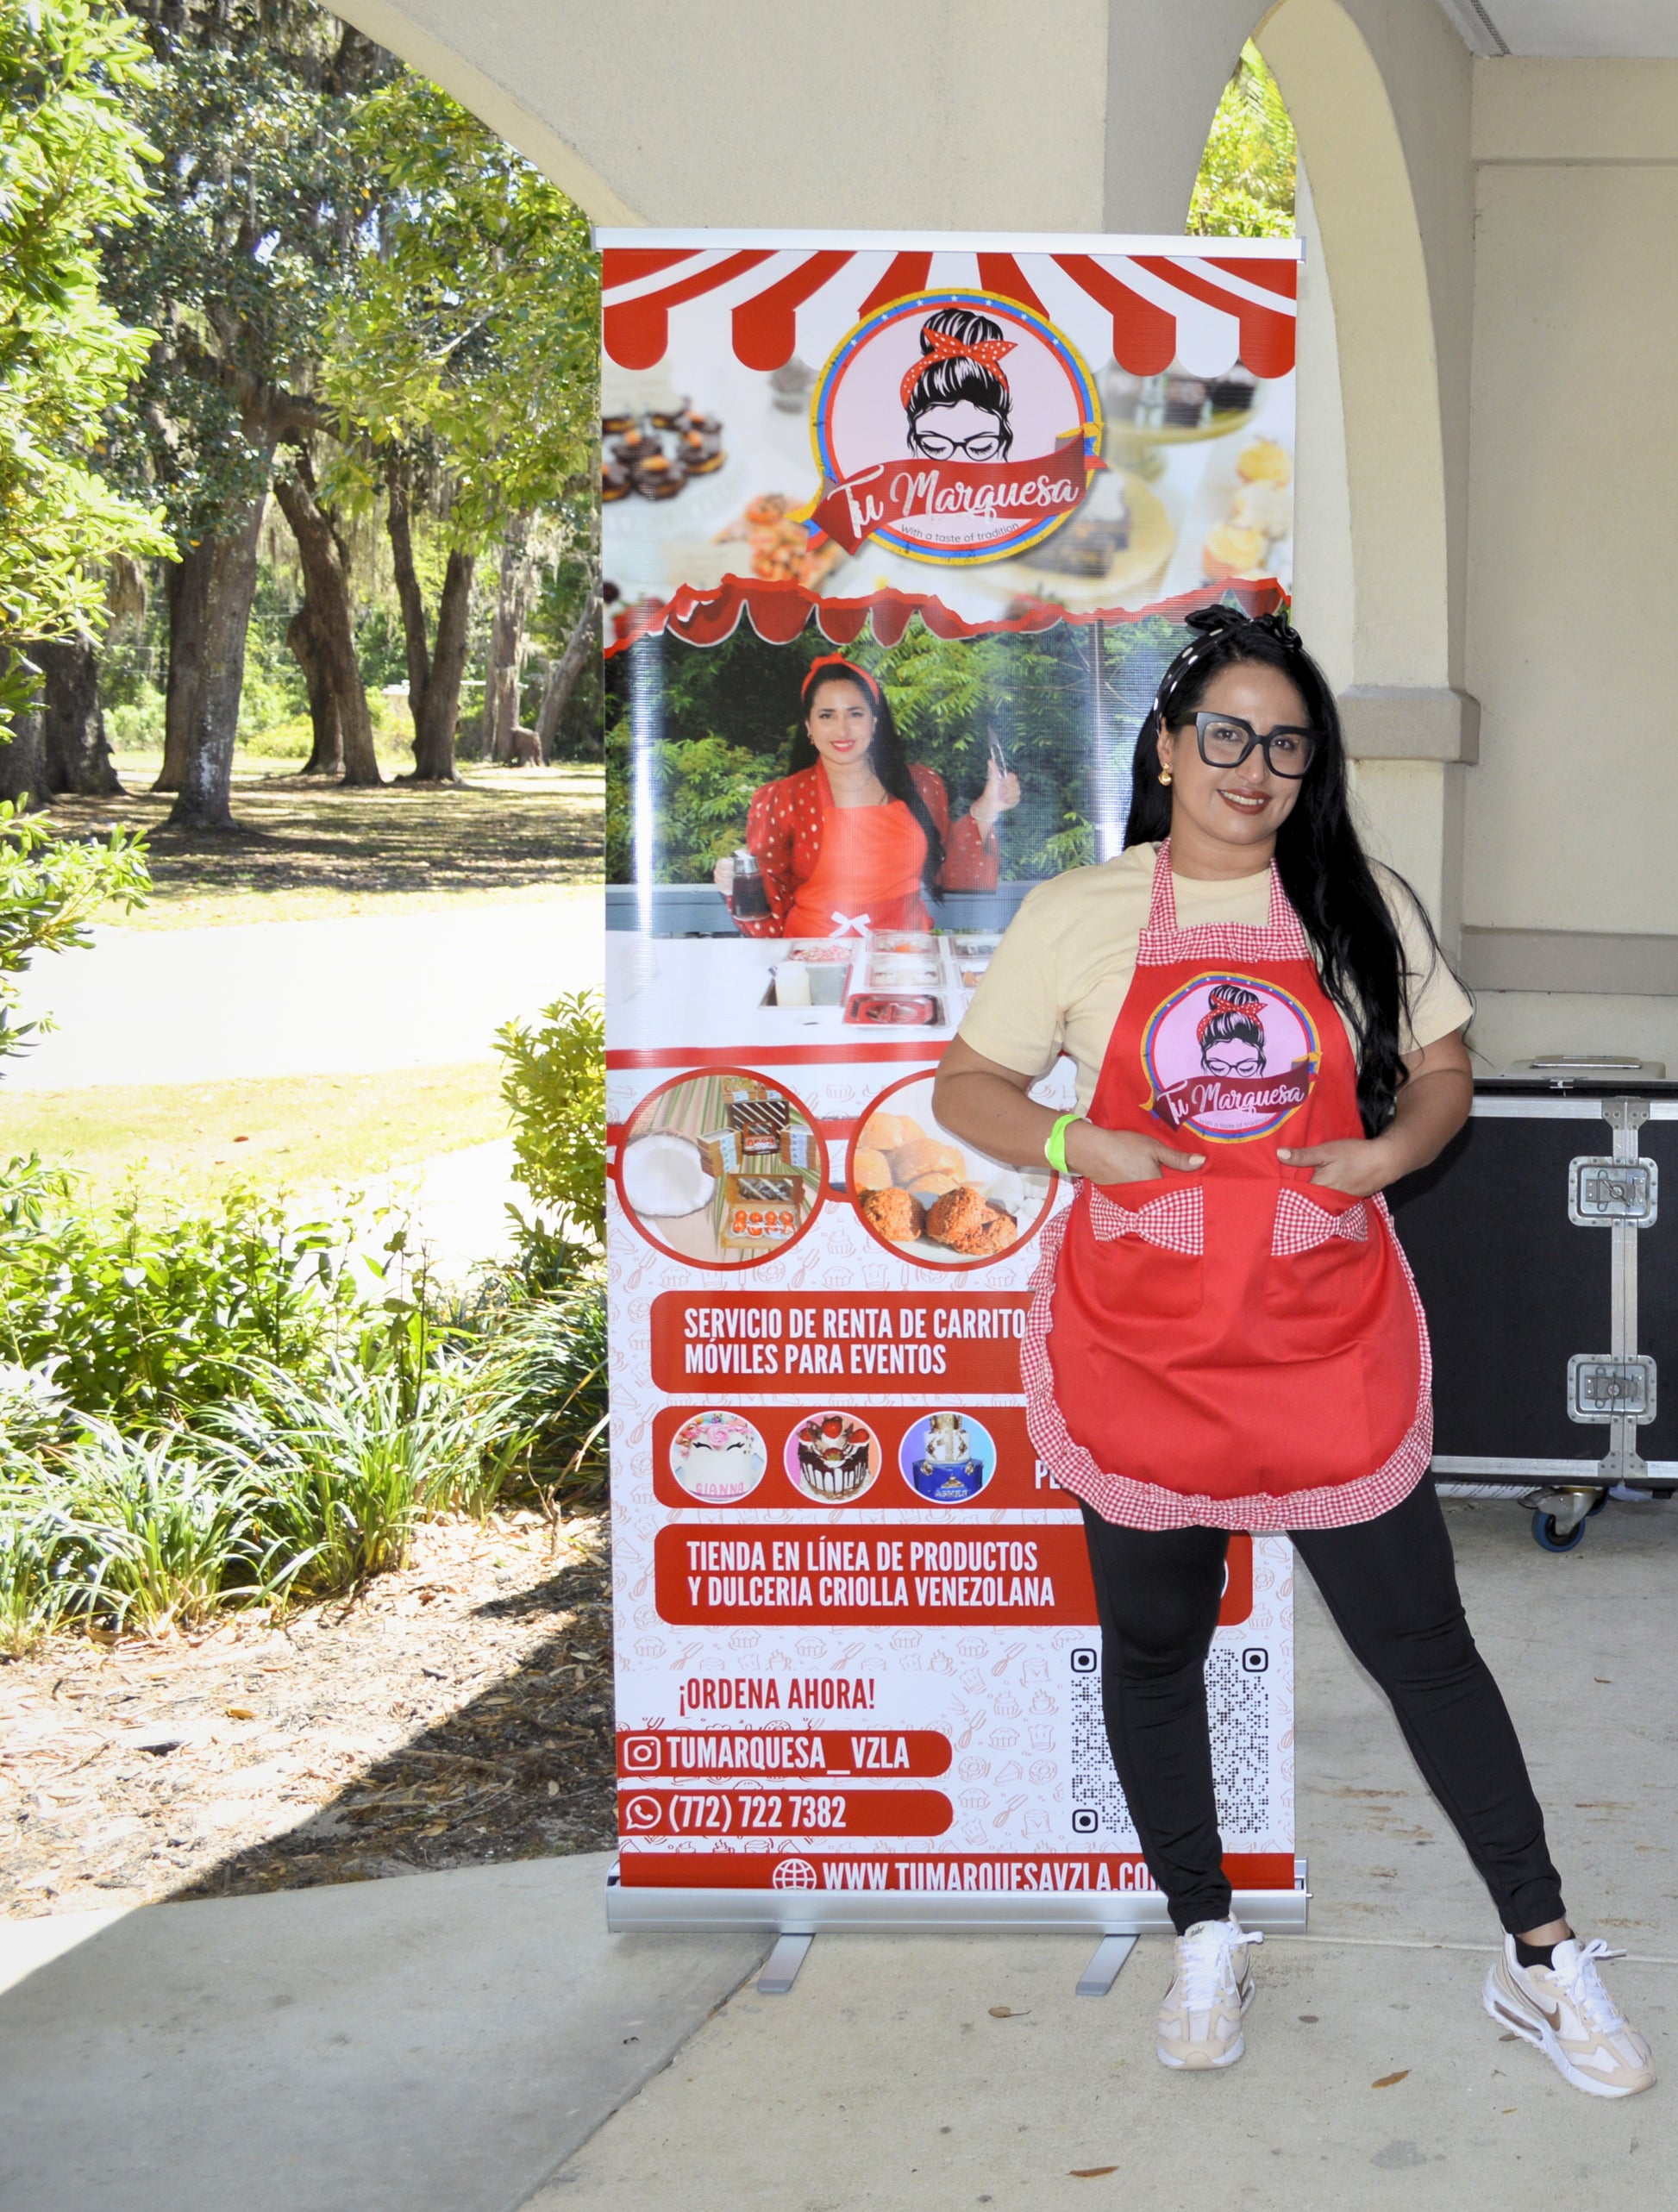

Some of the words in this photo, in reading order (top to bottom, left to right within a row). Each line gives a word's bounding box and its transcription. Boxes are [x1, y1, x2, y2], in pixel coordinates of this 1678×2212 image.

[827, 464, 884, 539] Tu
[890, 470, 1079, 521] Marquesa
[901, 523, 924, 538] With
[924, 532, 932, 541] a
[935, 533, 961, 543] taste
[963, 532, 974, 542] of
[977, 523, 1019, 541] tradition
[1156, 1080, 1188, 1125] Tu
[1191, 1082, 1305, 1114] Marquesa
[684, 1307, 782, 1339] SERVICIO
[789, 1307, 817, 1338] DE
[823, 1307, 893, 1338] RENTA
[899, 1307, 927, 1338] DE
[933, 1307, 1030, 1339] CARRITO
[685, 1338, 779, 1375] MÓVILES
[785, 1344, 844, 1374] PARA
[850, 1344, 947, 1375] EVENTOS
[695, 1482, 744, 1495] GIANNA
[686, 1541, 767, 1571] TIENDA
[773, 1541, 800, 1571] EN
[807, 1535, 870, 1571] LÍNEA
[876, 1541, 904, 1571] DE
[910, 1541, 1038, 1572] PRODUCTOS
[687, 1576, 702, 1606] Y
[708, 1576, 813, 1607] DULCERIA
[819, 1576, 909, 1607] CRIOLLA
[914, 1576, 1055, 1607] VENEZOLANA
[679, 1677, 780, 1716] ¡ORDENA
[787, 1678, 875, 1709] AHORA!
[669, 1795, 732, 1833] (772)
[738, 1795, 782, 1827] 722
[788, 1795, 847, 1828] 7382
[823, 1862, 1160, 1891] WWW.TUMARQUESAVZLA.CO
